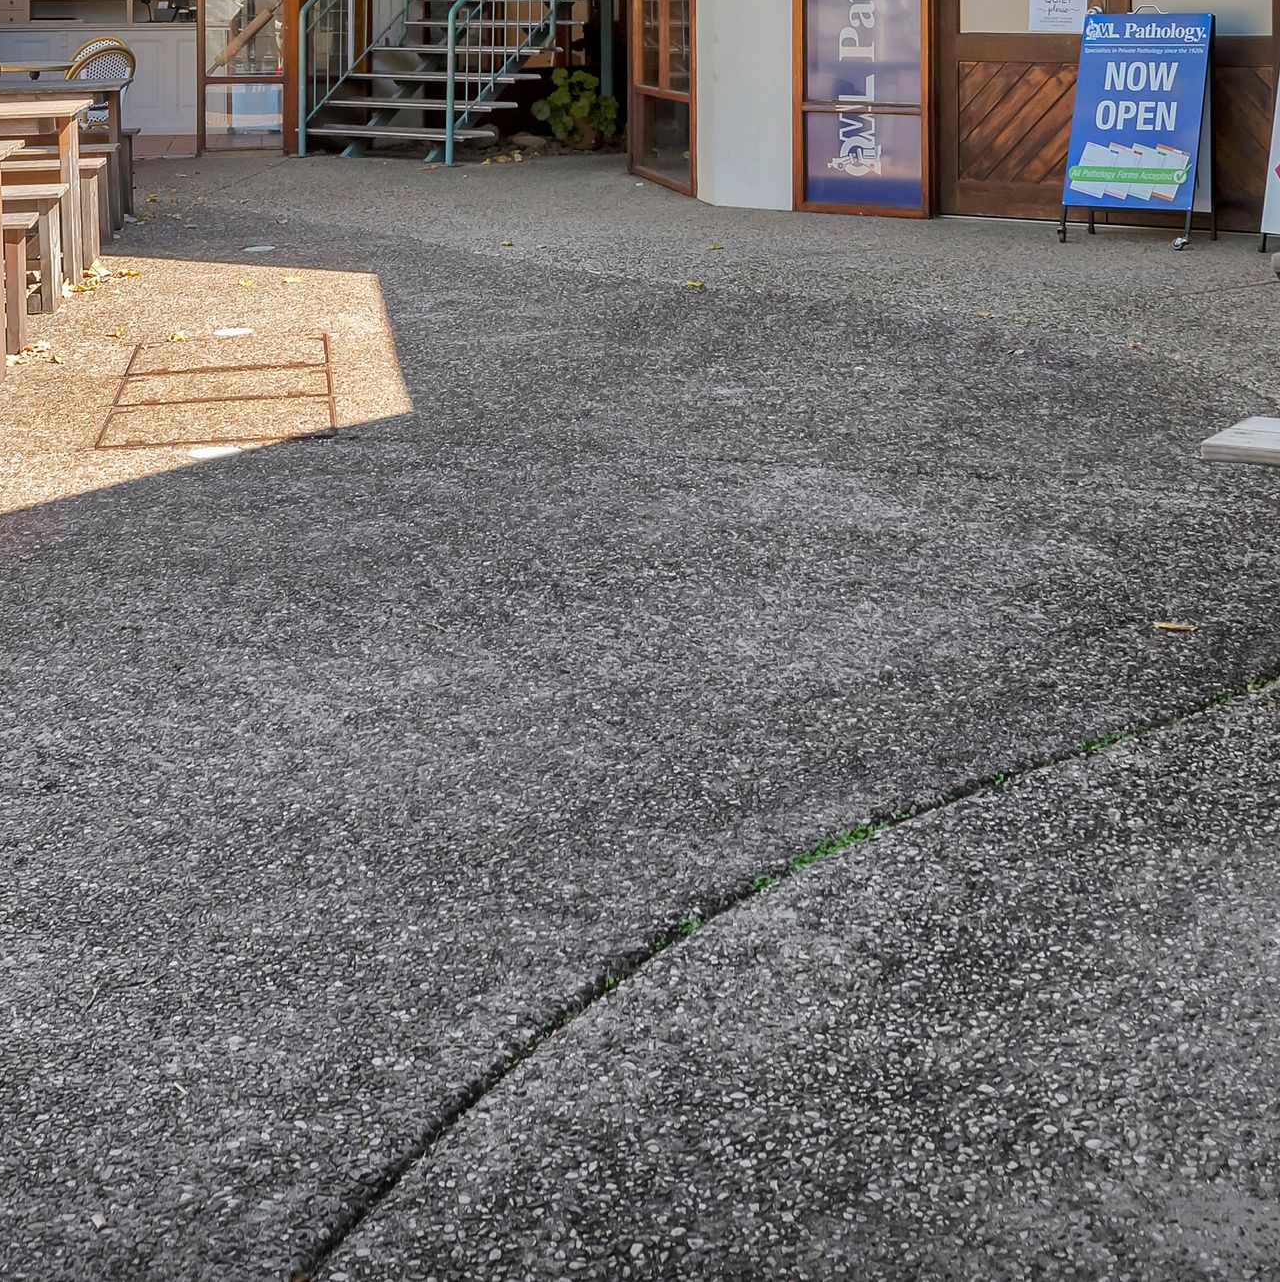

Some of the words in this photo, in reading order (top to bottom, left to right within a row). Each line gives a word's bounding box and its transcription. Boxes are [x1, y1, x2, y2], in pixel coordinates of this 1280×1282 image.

[1124, 22, 1207, 42] Pathology.
[1104, 61, 1179, 92] NOW
[1095, 100, 1178, 131] OPEN
[1070, 168, 1082, 177] All
[1082, 169, 1117, 179] Pathology
[1117, 170, 1140, 179] Forms
[1140, 171, 1173, 181] Accepted
